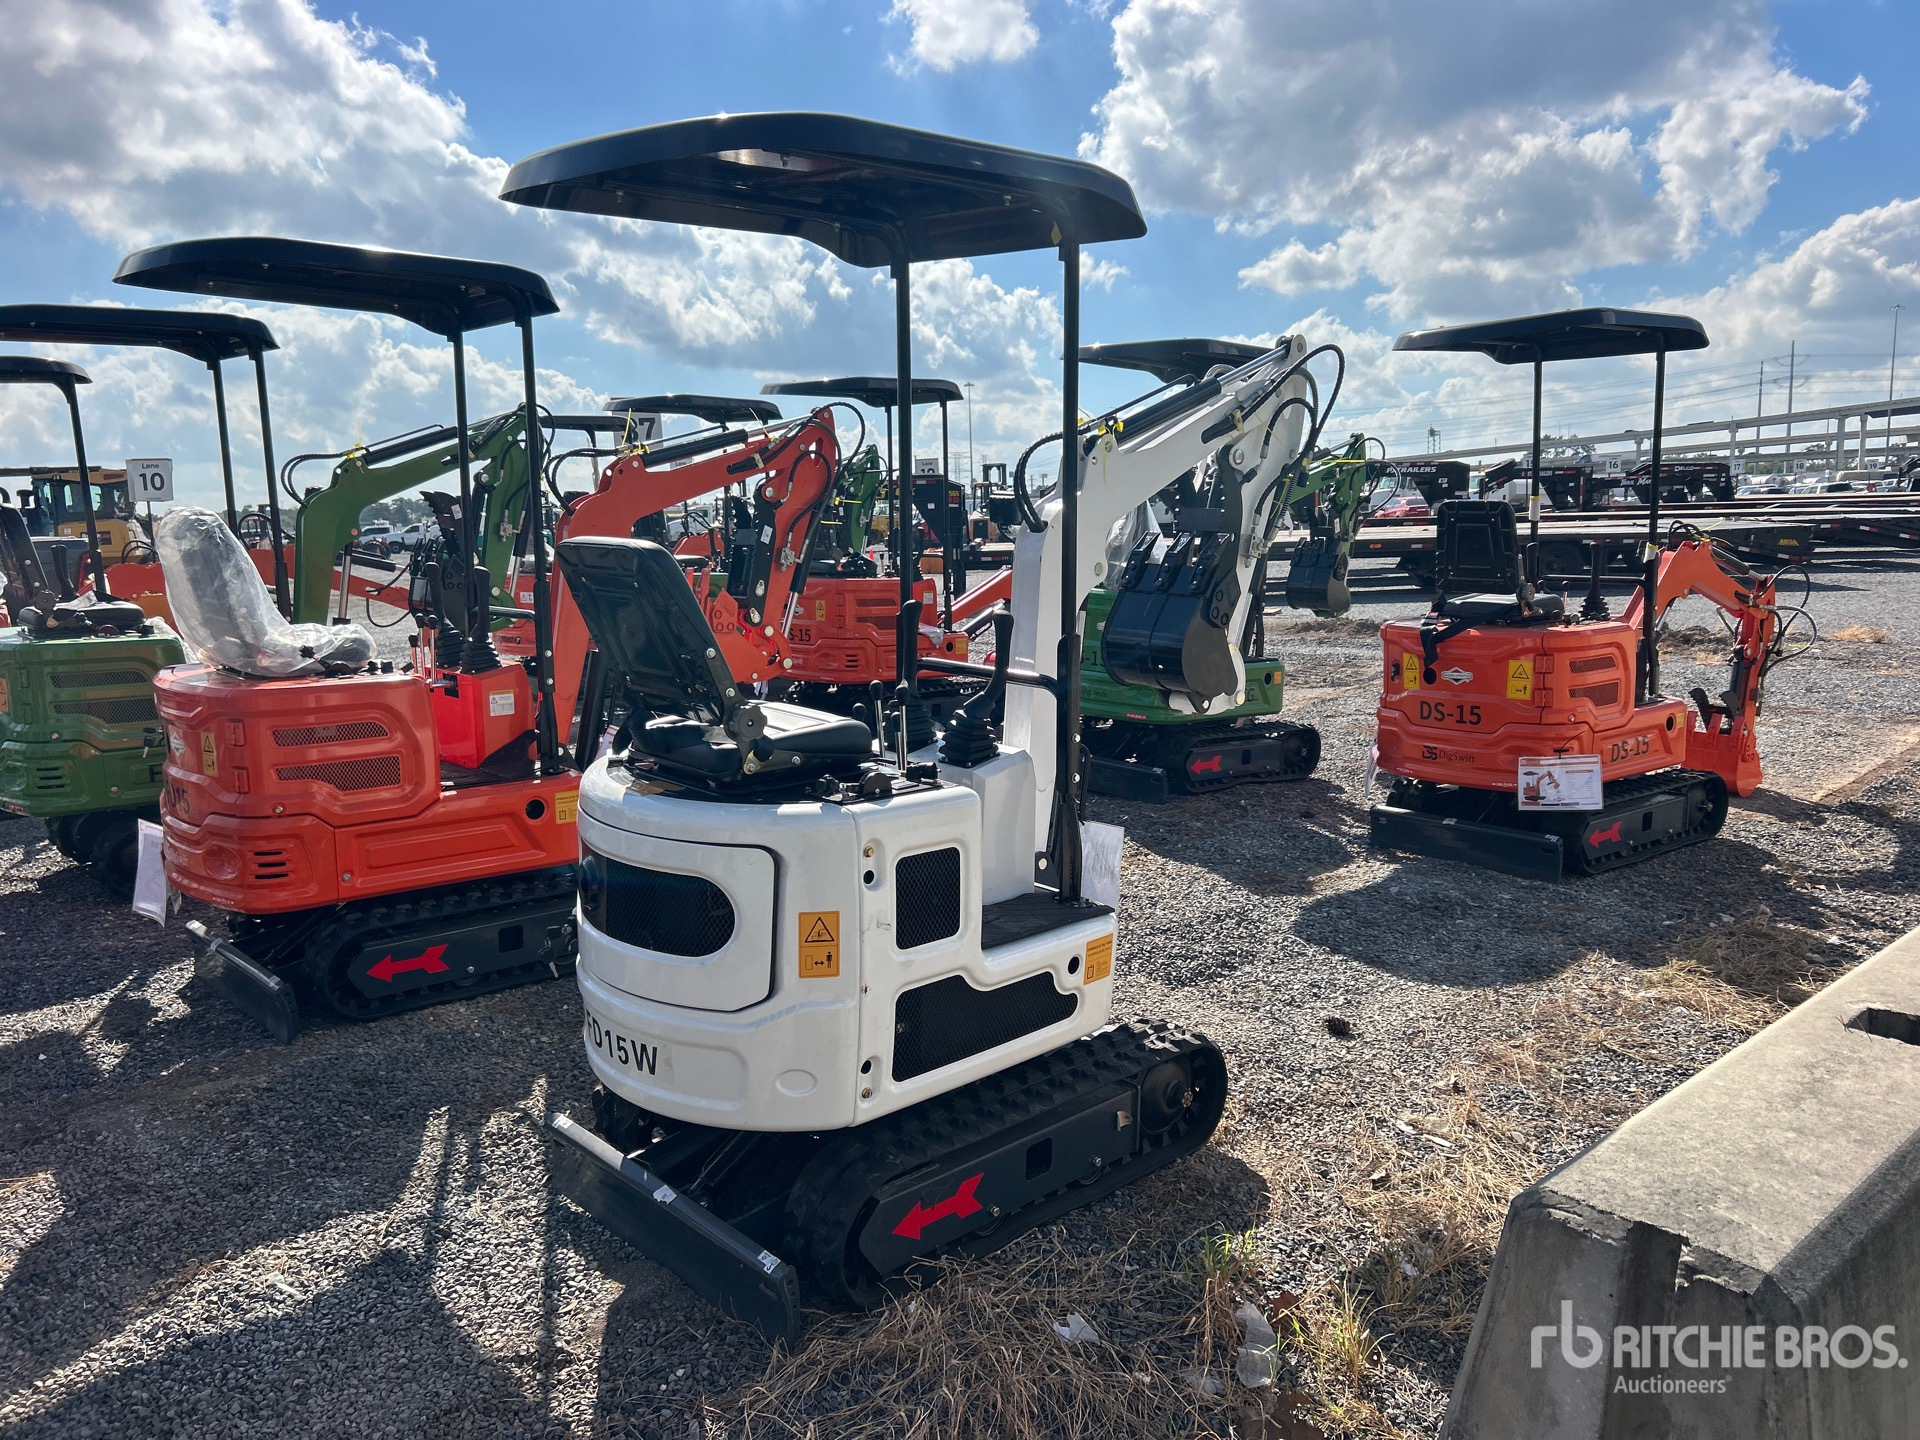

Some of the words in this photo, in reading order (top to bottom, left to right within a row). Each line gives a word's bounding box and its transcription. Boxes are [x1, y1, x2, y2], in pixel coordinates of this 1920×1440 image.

[1608, 460, 1619, 469] 16
[1796, 462, 1805, 470] 18
[1869, 462, 1878, 470] 19
[139, 472, 165, 491] 10
[788, 627, 811, 642] S-15
[1419, 700, 1482, 726] DS-15
[1610, 735, 1649, 763] DS-15
[1438, 750, 1475, 763] DigSwift
